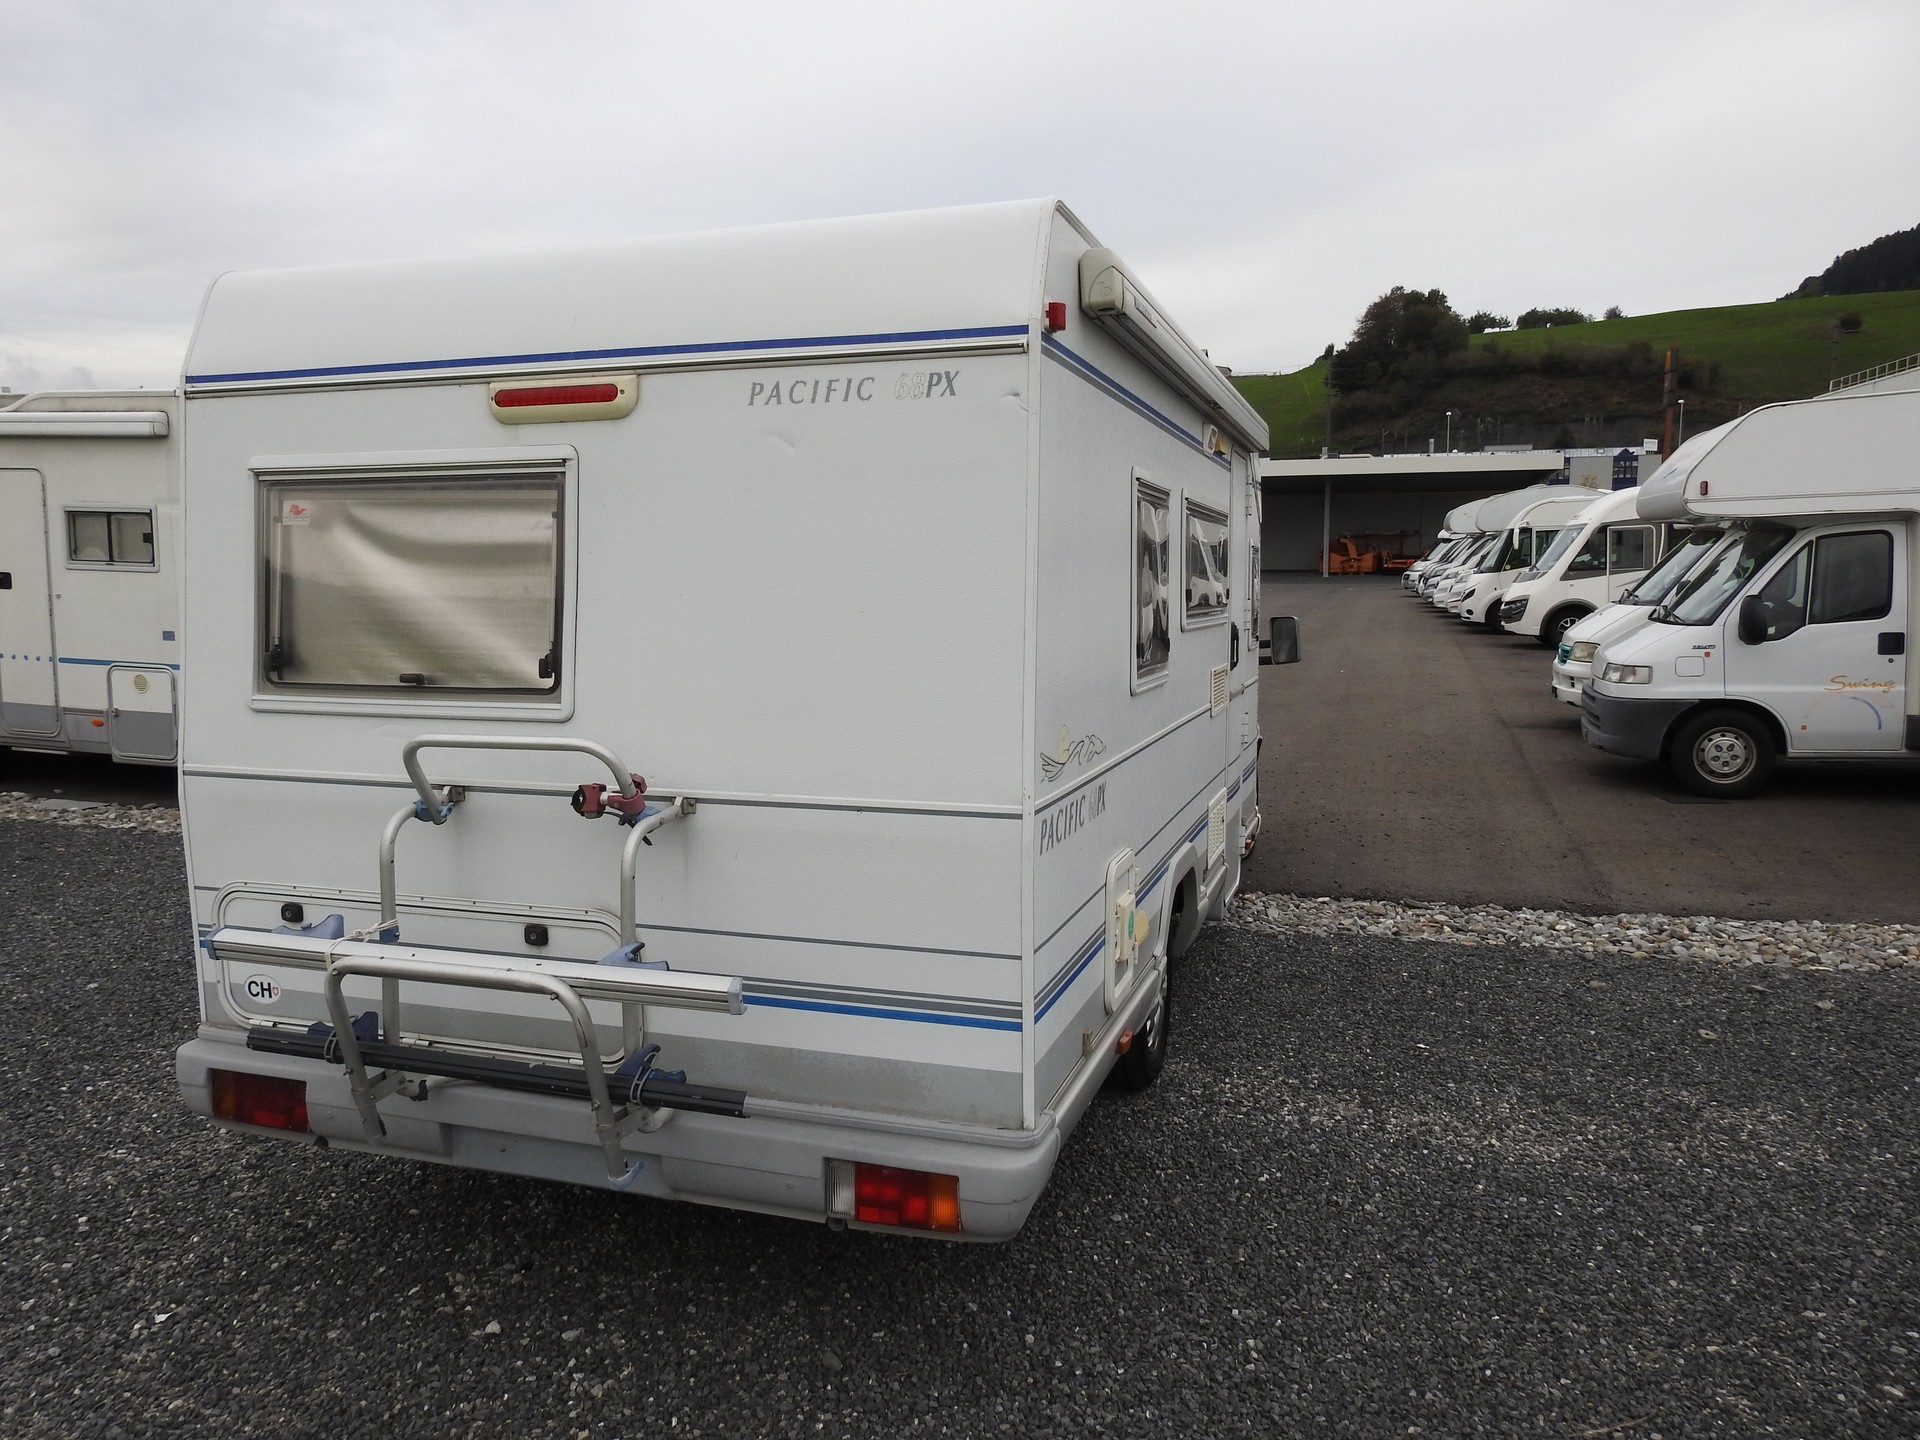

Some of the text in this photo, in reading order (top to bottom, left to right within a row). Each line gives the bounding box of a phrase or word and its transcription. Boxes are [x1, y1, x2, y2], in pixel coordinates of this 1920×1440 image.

[748, 370, 960, 406] PACIFIC 68PX
[1823, 674, 1896, 694] Swing
[1039, 794, 1086, 857] PACIFIC
[247, 980, 272, 999] CH
